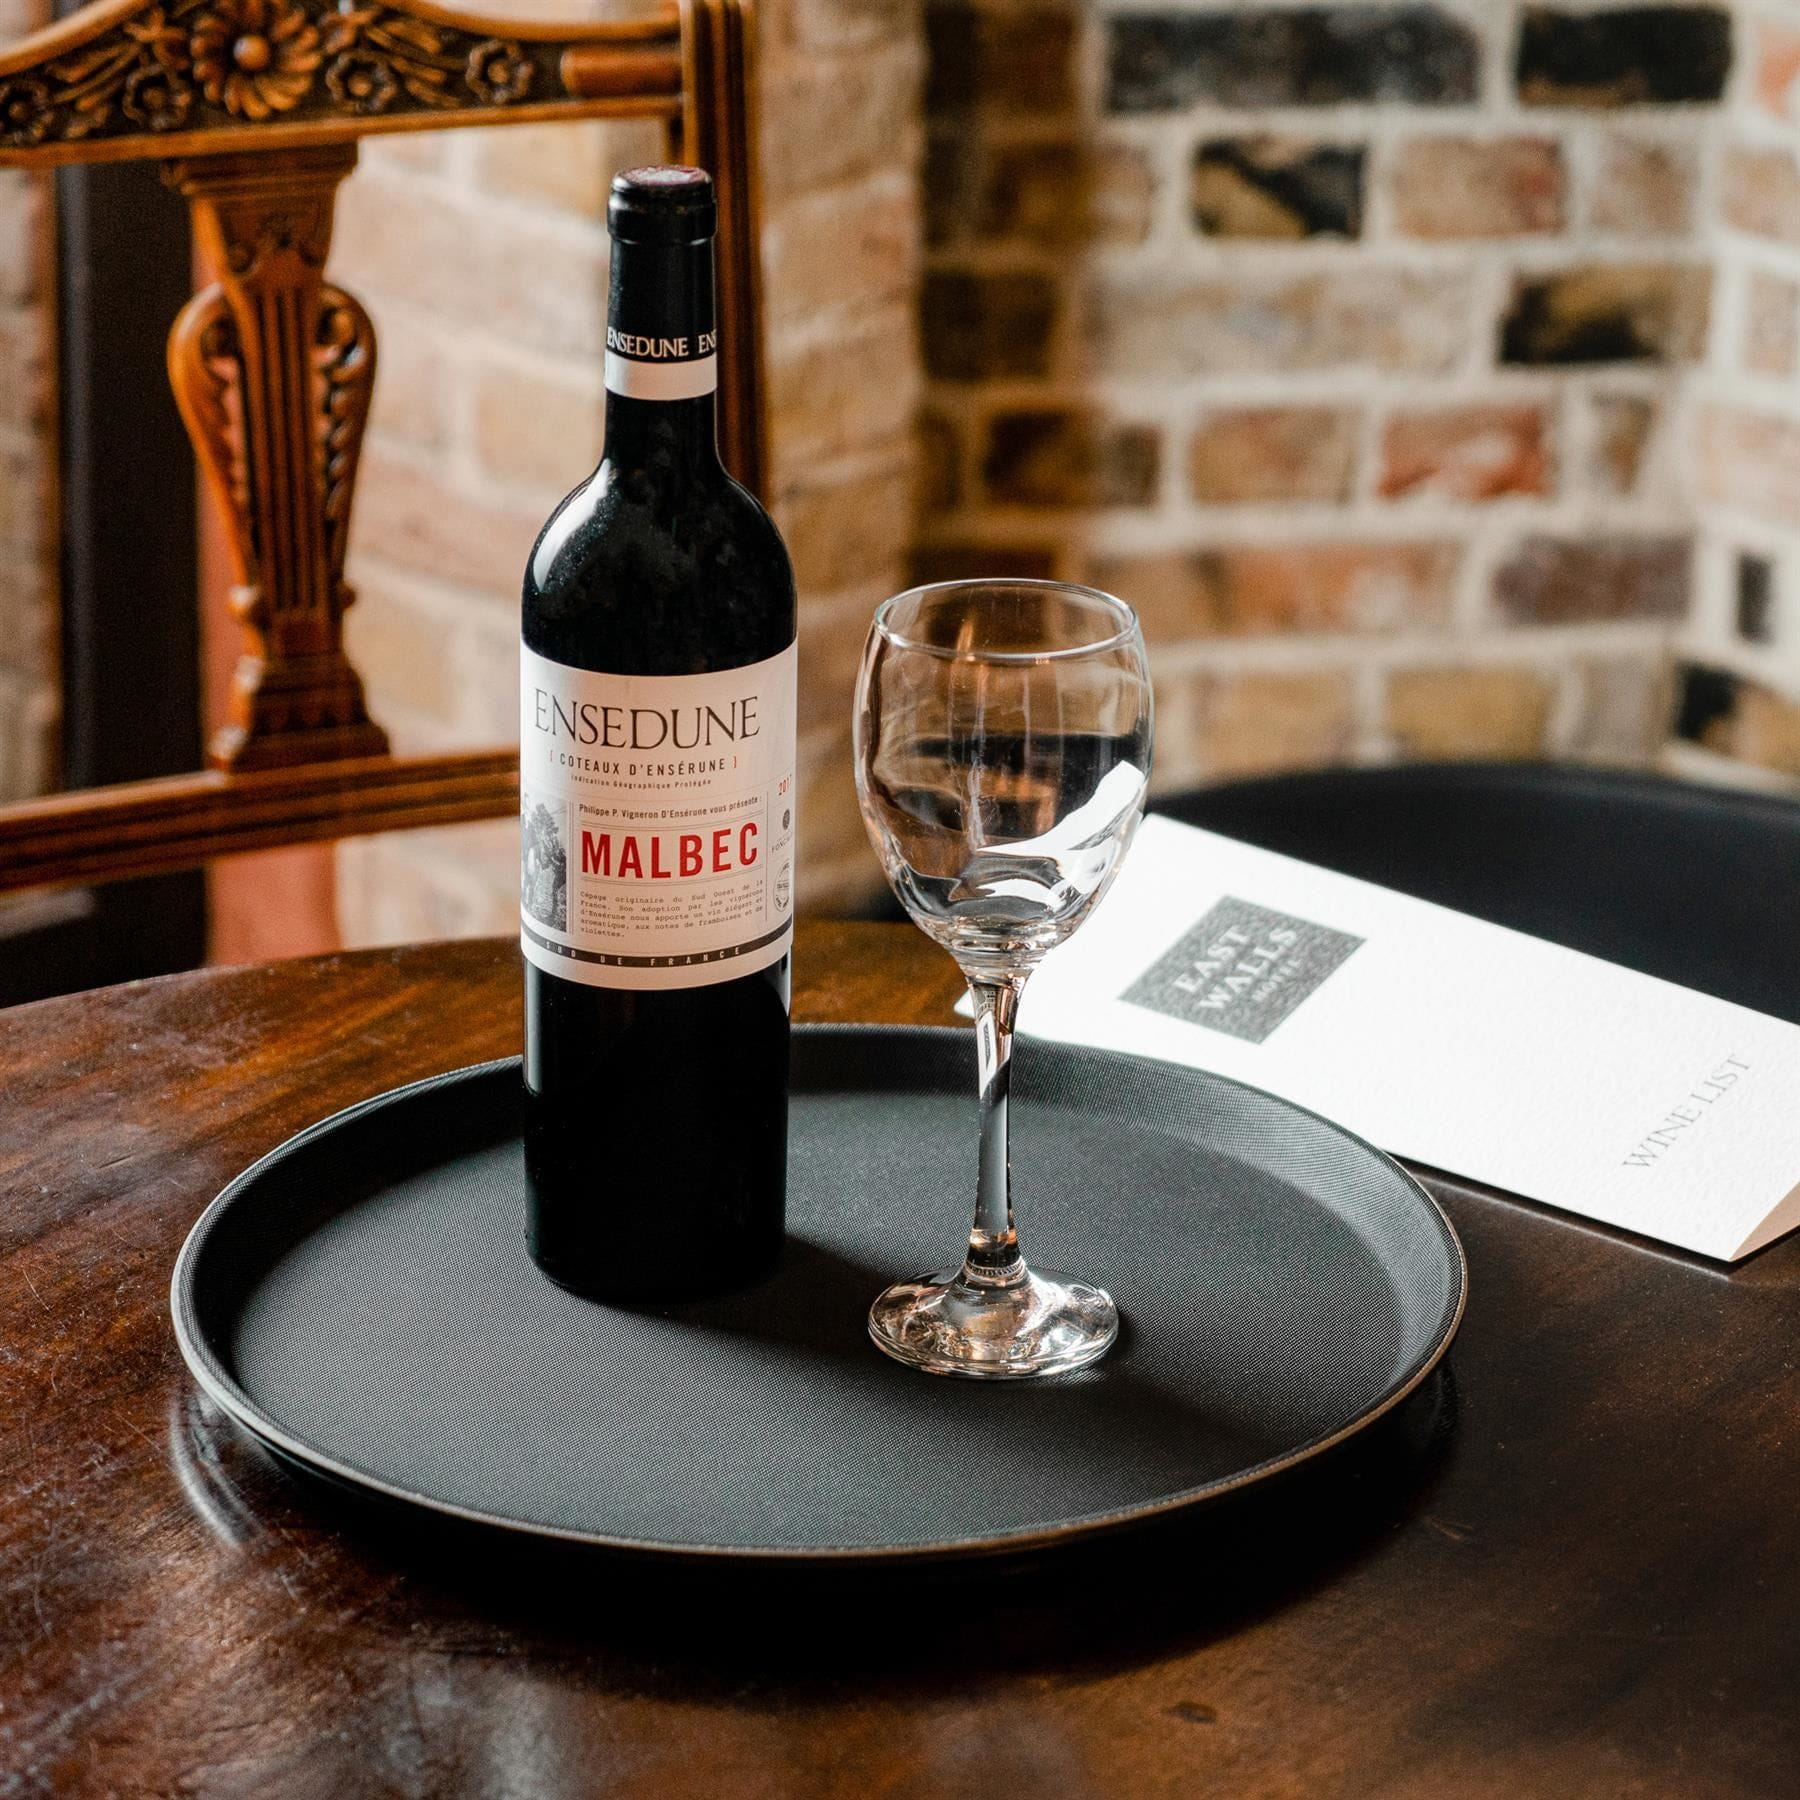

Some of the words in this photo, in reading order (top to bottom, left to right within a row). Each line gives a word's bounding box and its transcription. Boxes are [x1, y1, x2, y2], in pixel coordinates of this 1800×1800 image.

[607, 326, 689, 358] ENSEDUNE
[535, 688, 761, 750] ENSEDUNE
[560, 753, 620, 775] COTEAUX
[629, 758, 726, 777] D'ENSÉRUNE
[571, 774, 610, 786] Indication
[613, 780, 671, 790] Géographique
[579, 803, 610, 817] Philippe
[612, 809, 620, 818] P.
[621, 810, 659, 820] Vigneron
[661, 807, 708, 819] D'Ensérune
[709, 804, 727, 813] vous
[728, 796, 759, 811] présente
[580, 822, 759, 880] MALBEC
[580, 899, 611, 911] France.
[641, 905, 681, 914] adoption
[687, 904, 702, 912] par
[691, 894, 706, 902] Sud
[713, 888, 736, 898] Ouest
[580, 918, 630, 930] aromatique,
[654, 913, 689, 923] apporte
[580, 927, 625, 938] violettes.
[546, 941, 577, 959] SUD
[600, 956, 623, 967] DE
[650, 946, 740, 966] FRANCE
[1171, 924, 1249, 993] EAST
[1197, 927, 1297, 1009] WALLS
[1621, 1104, 1703, 1168] WINE
[1690, 1053, 1751, 1106] LIST
